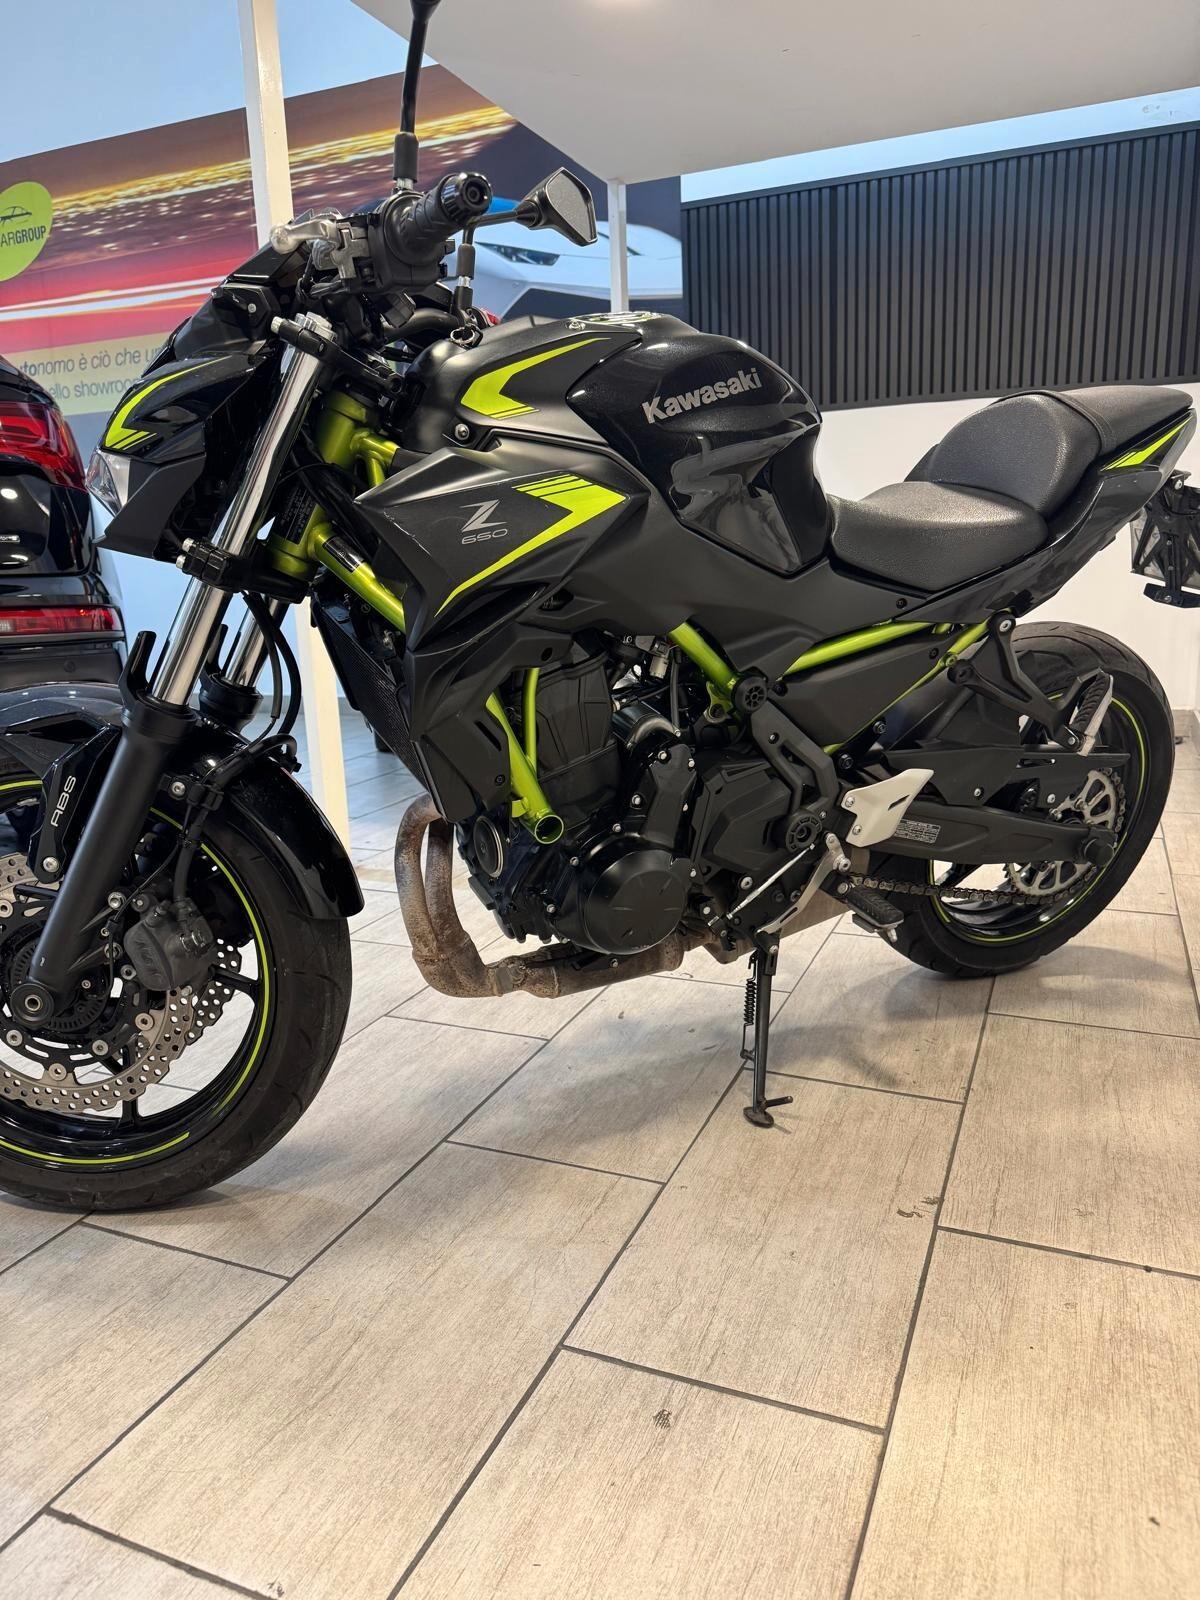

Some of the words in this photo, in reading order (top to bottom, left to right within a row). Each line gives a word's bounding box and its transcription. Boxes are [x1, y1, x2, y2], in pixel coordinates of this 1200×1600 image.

[79, 353, 88, 370] è
[91, 350, 111, 368] ciò
[115, 347, 141, 367] che
[641, 367, 762, 424] Kawasaki
[461, 528, 508, 545] 650
[50, 775, 77, 827] ABS
